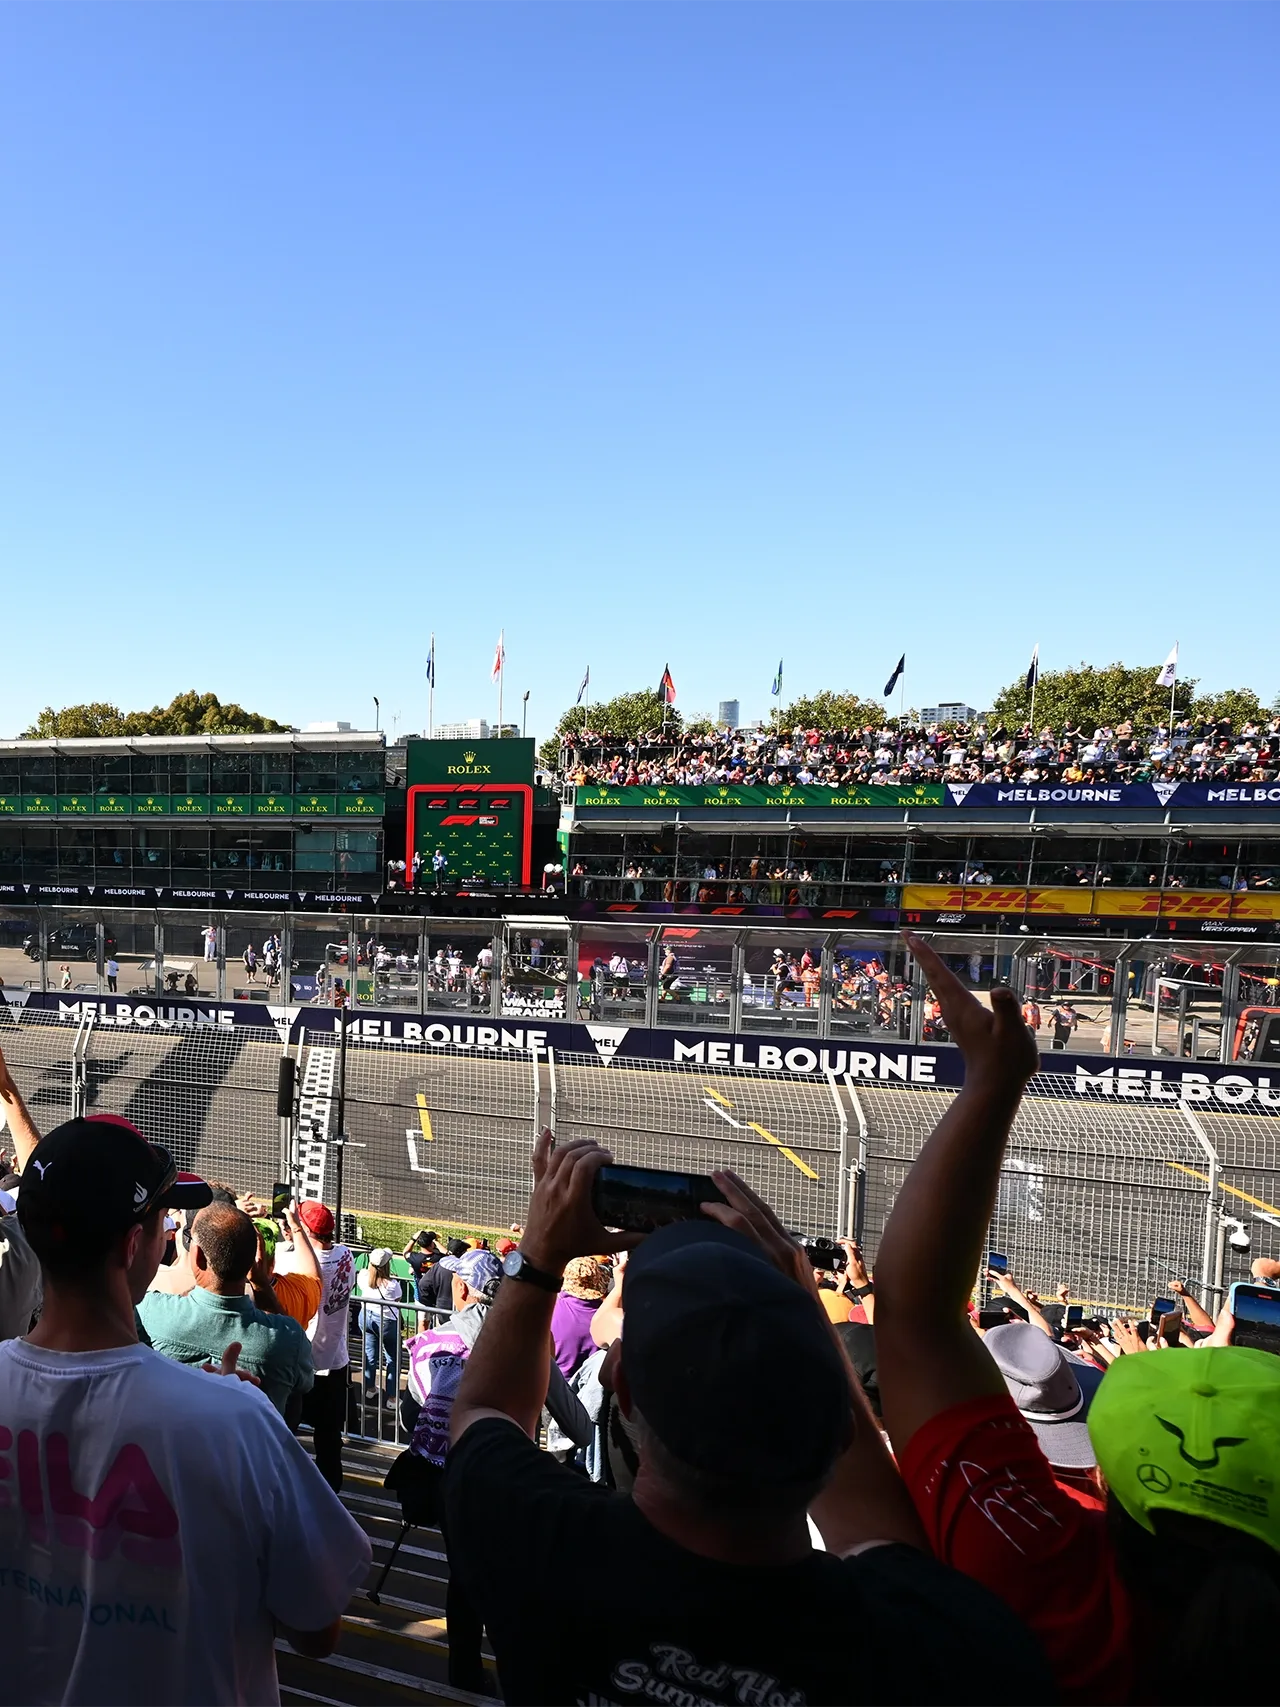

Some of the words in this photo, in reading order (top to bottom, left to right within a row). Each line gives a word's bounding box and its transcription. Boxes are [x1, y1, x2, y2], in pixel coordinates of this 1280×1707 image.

[447, 765, 492, 774] ROLEX
[997, 788, 1122, 801] MELBOURNE
[766, 797, 805, 805] ROLEX
[830, 797, 871, 805] ROLEX
[897, 797, 940, 805] ROLEX
[345, 805, 375, 813] ROLEX
[104, 888, 146, 896] MELBOURNE
[172, 890, 216, 898] MELBOURNE
[244, 892, 290, 900] MELBOURNE
[314, 894, 363, 903] MELBOURNE
[944, 890, 1044, 909] DHL
[1138, 895, 1252, 914] DHL
[906, 913, 920, 922] 11
[1168, 921, 1176, 930] 1
[7, 1000, 25, 1008] MEL
[502, 997, 564, 1010] WALKER
[58, 999, 235, 1032] MELBOURNE
[501, 1007, 566, 1018] STRAIGHT
[272, 1017, 293, 1026] MEL
[333, 1016, 549, 1055] MELBOURNE
[593, 1037, 619, 1049] MEL
[673, 1038, 938, 1083] MELBOURNE
[651, 1644, 729, 1690] Red
